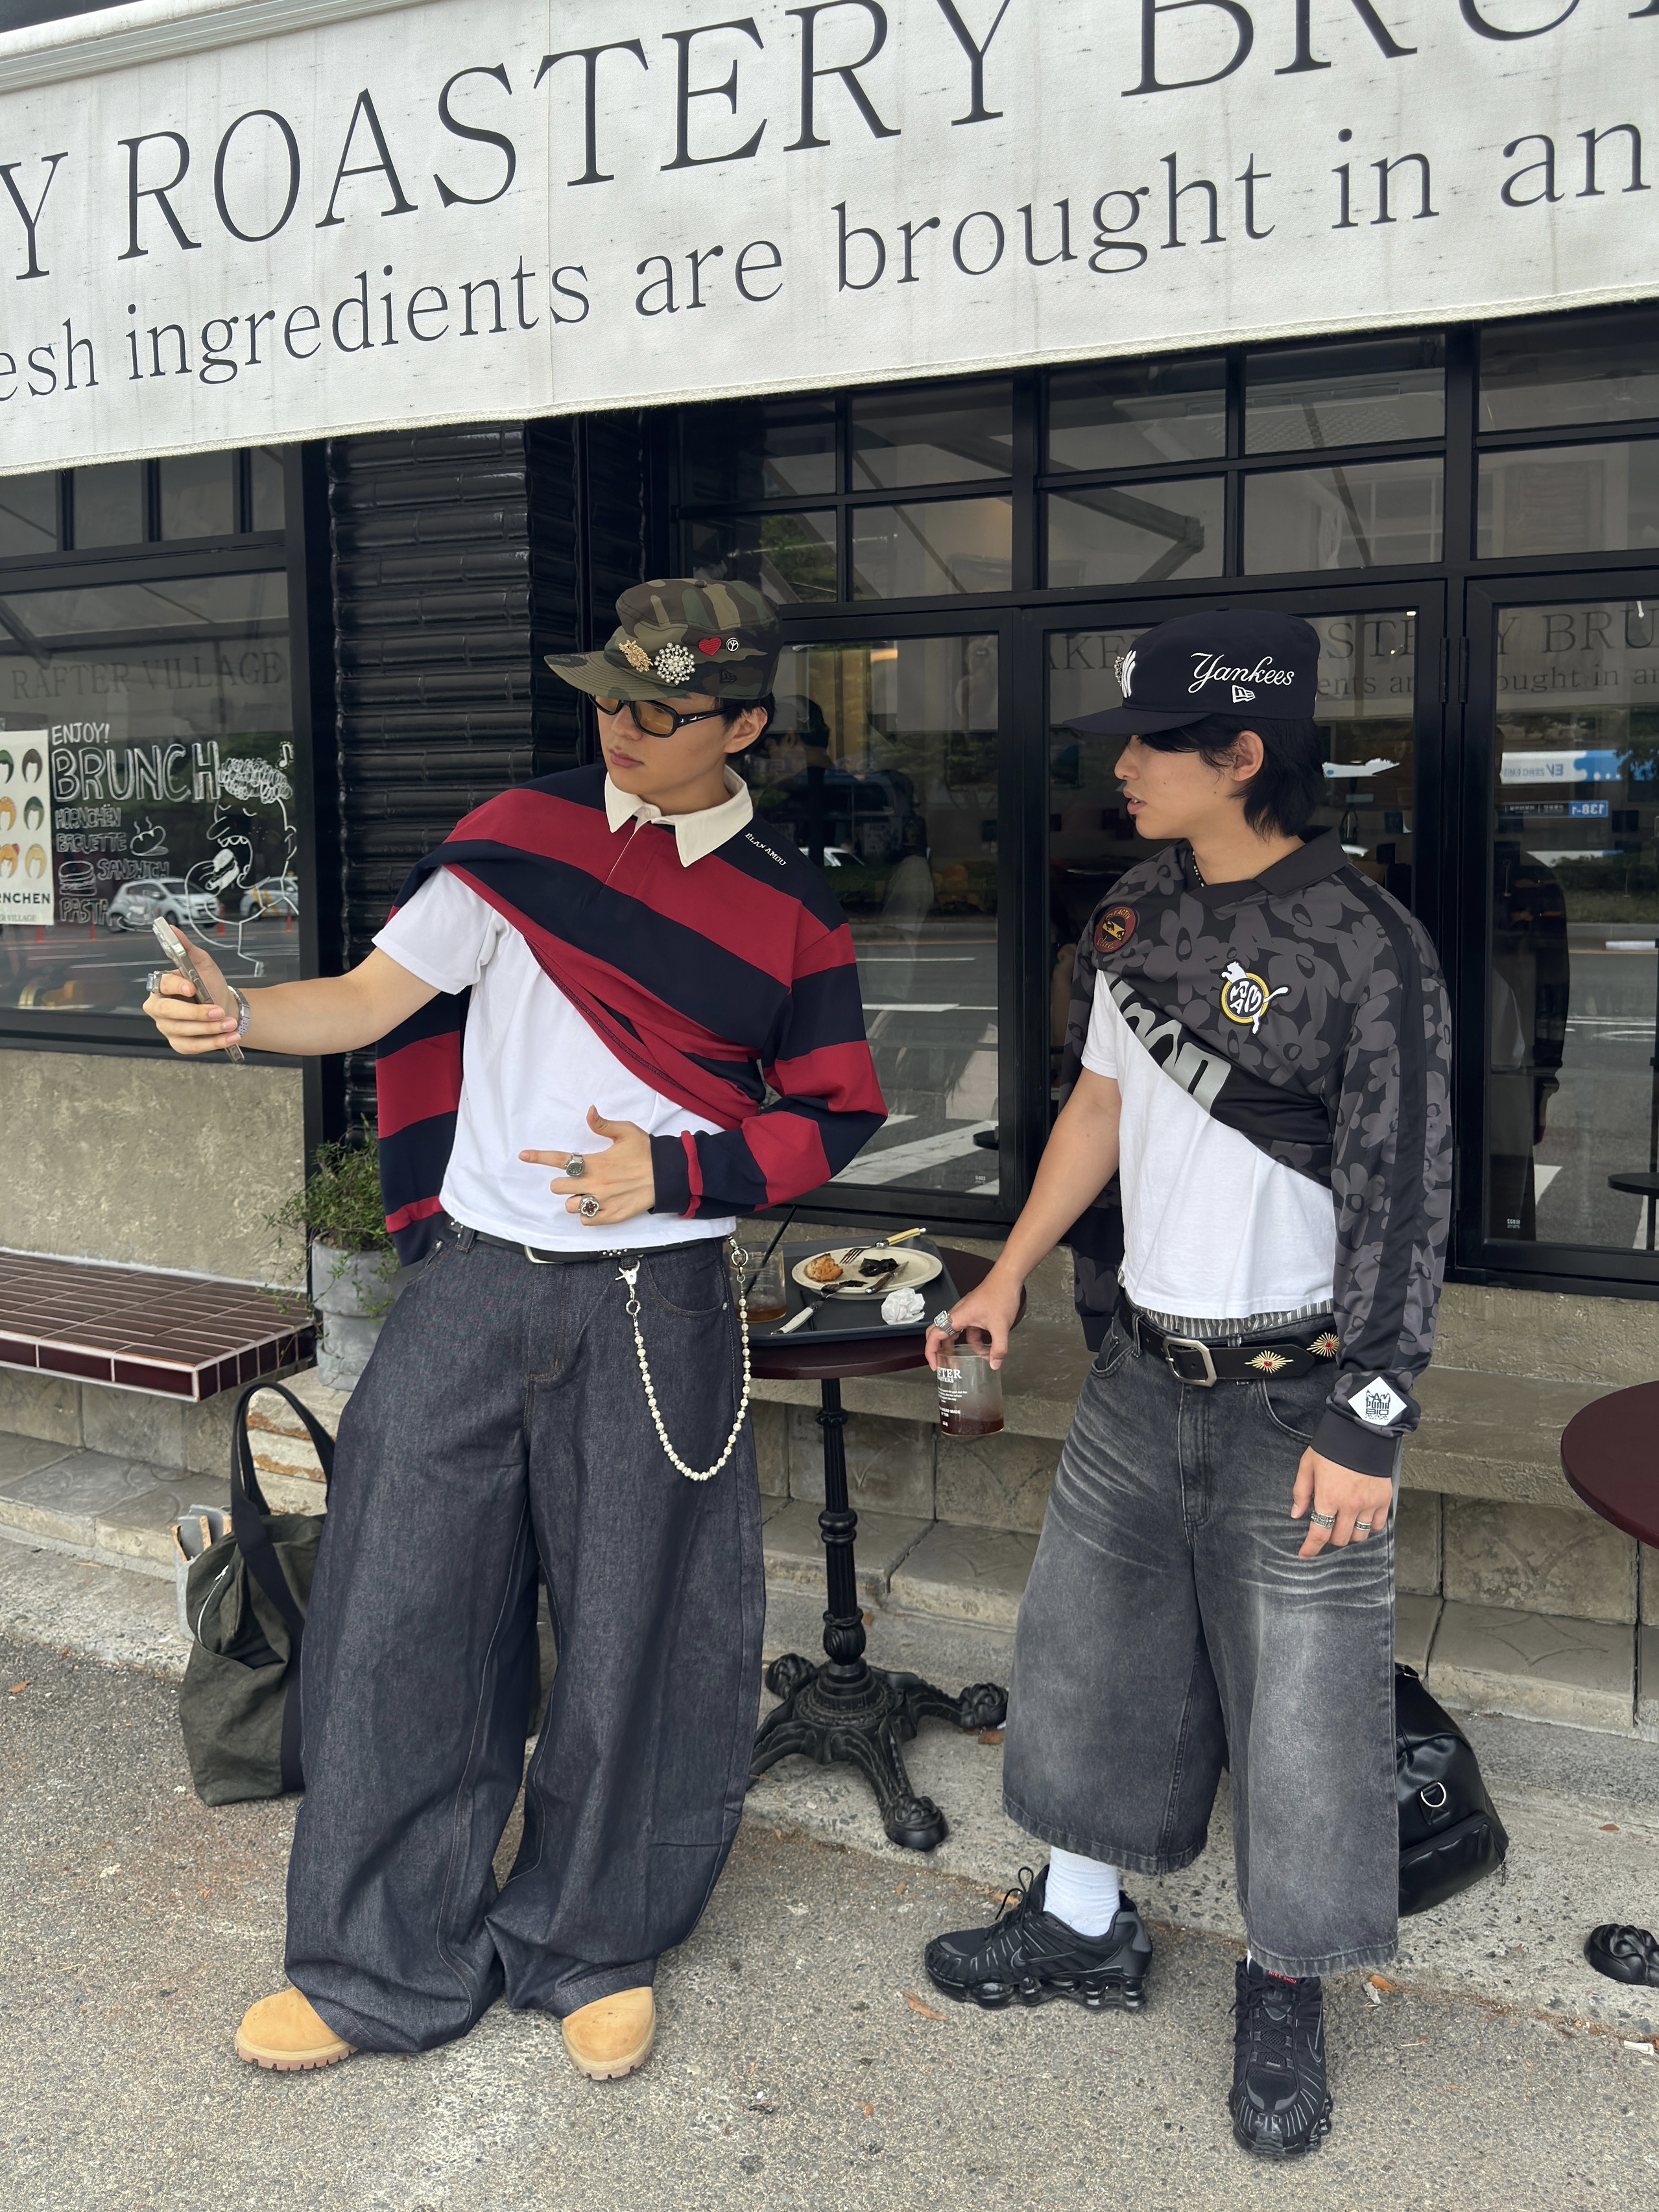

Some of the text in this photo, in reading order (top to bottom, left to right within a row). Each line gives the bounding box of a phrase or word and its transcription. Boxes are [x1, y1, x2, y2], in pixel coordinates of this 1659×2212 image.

[117, 0, 1011, 261] ROASTERY
[126, 256, 590, 385] ingredients
[635, 240, 783, 316] are
[831, 151, 1276, 292] brought
[1331, 128, 1439, 229] in
[1500, 123, 1651, 208] an
[12, 652, 283, 700] RAFTER VILLAGE
[1188, 652, 1295, 693] Yankees
[52, 722, 110, 744] ENJOY!
[51, 741, 221, 802] BRUNCH
[0, 892, 50, 904] NCHEN
